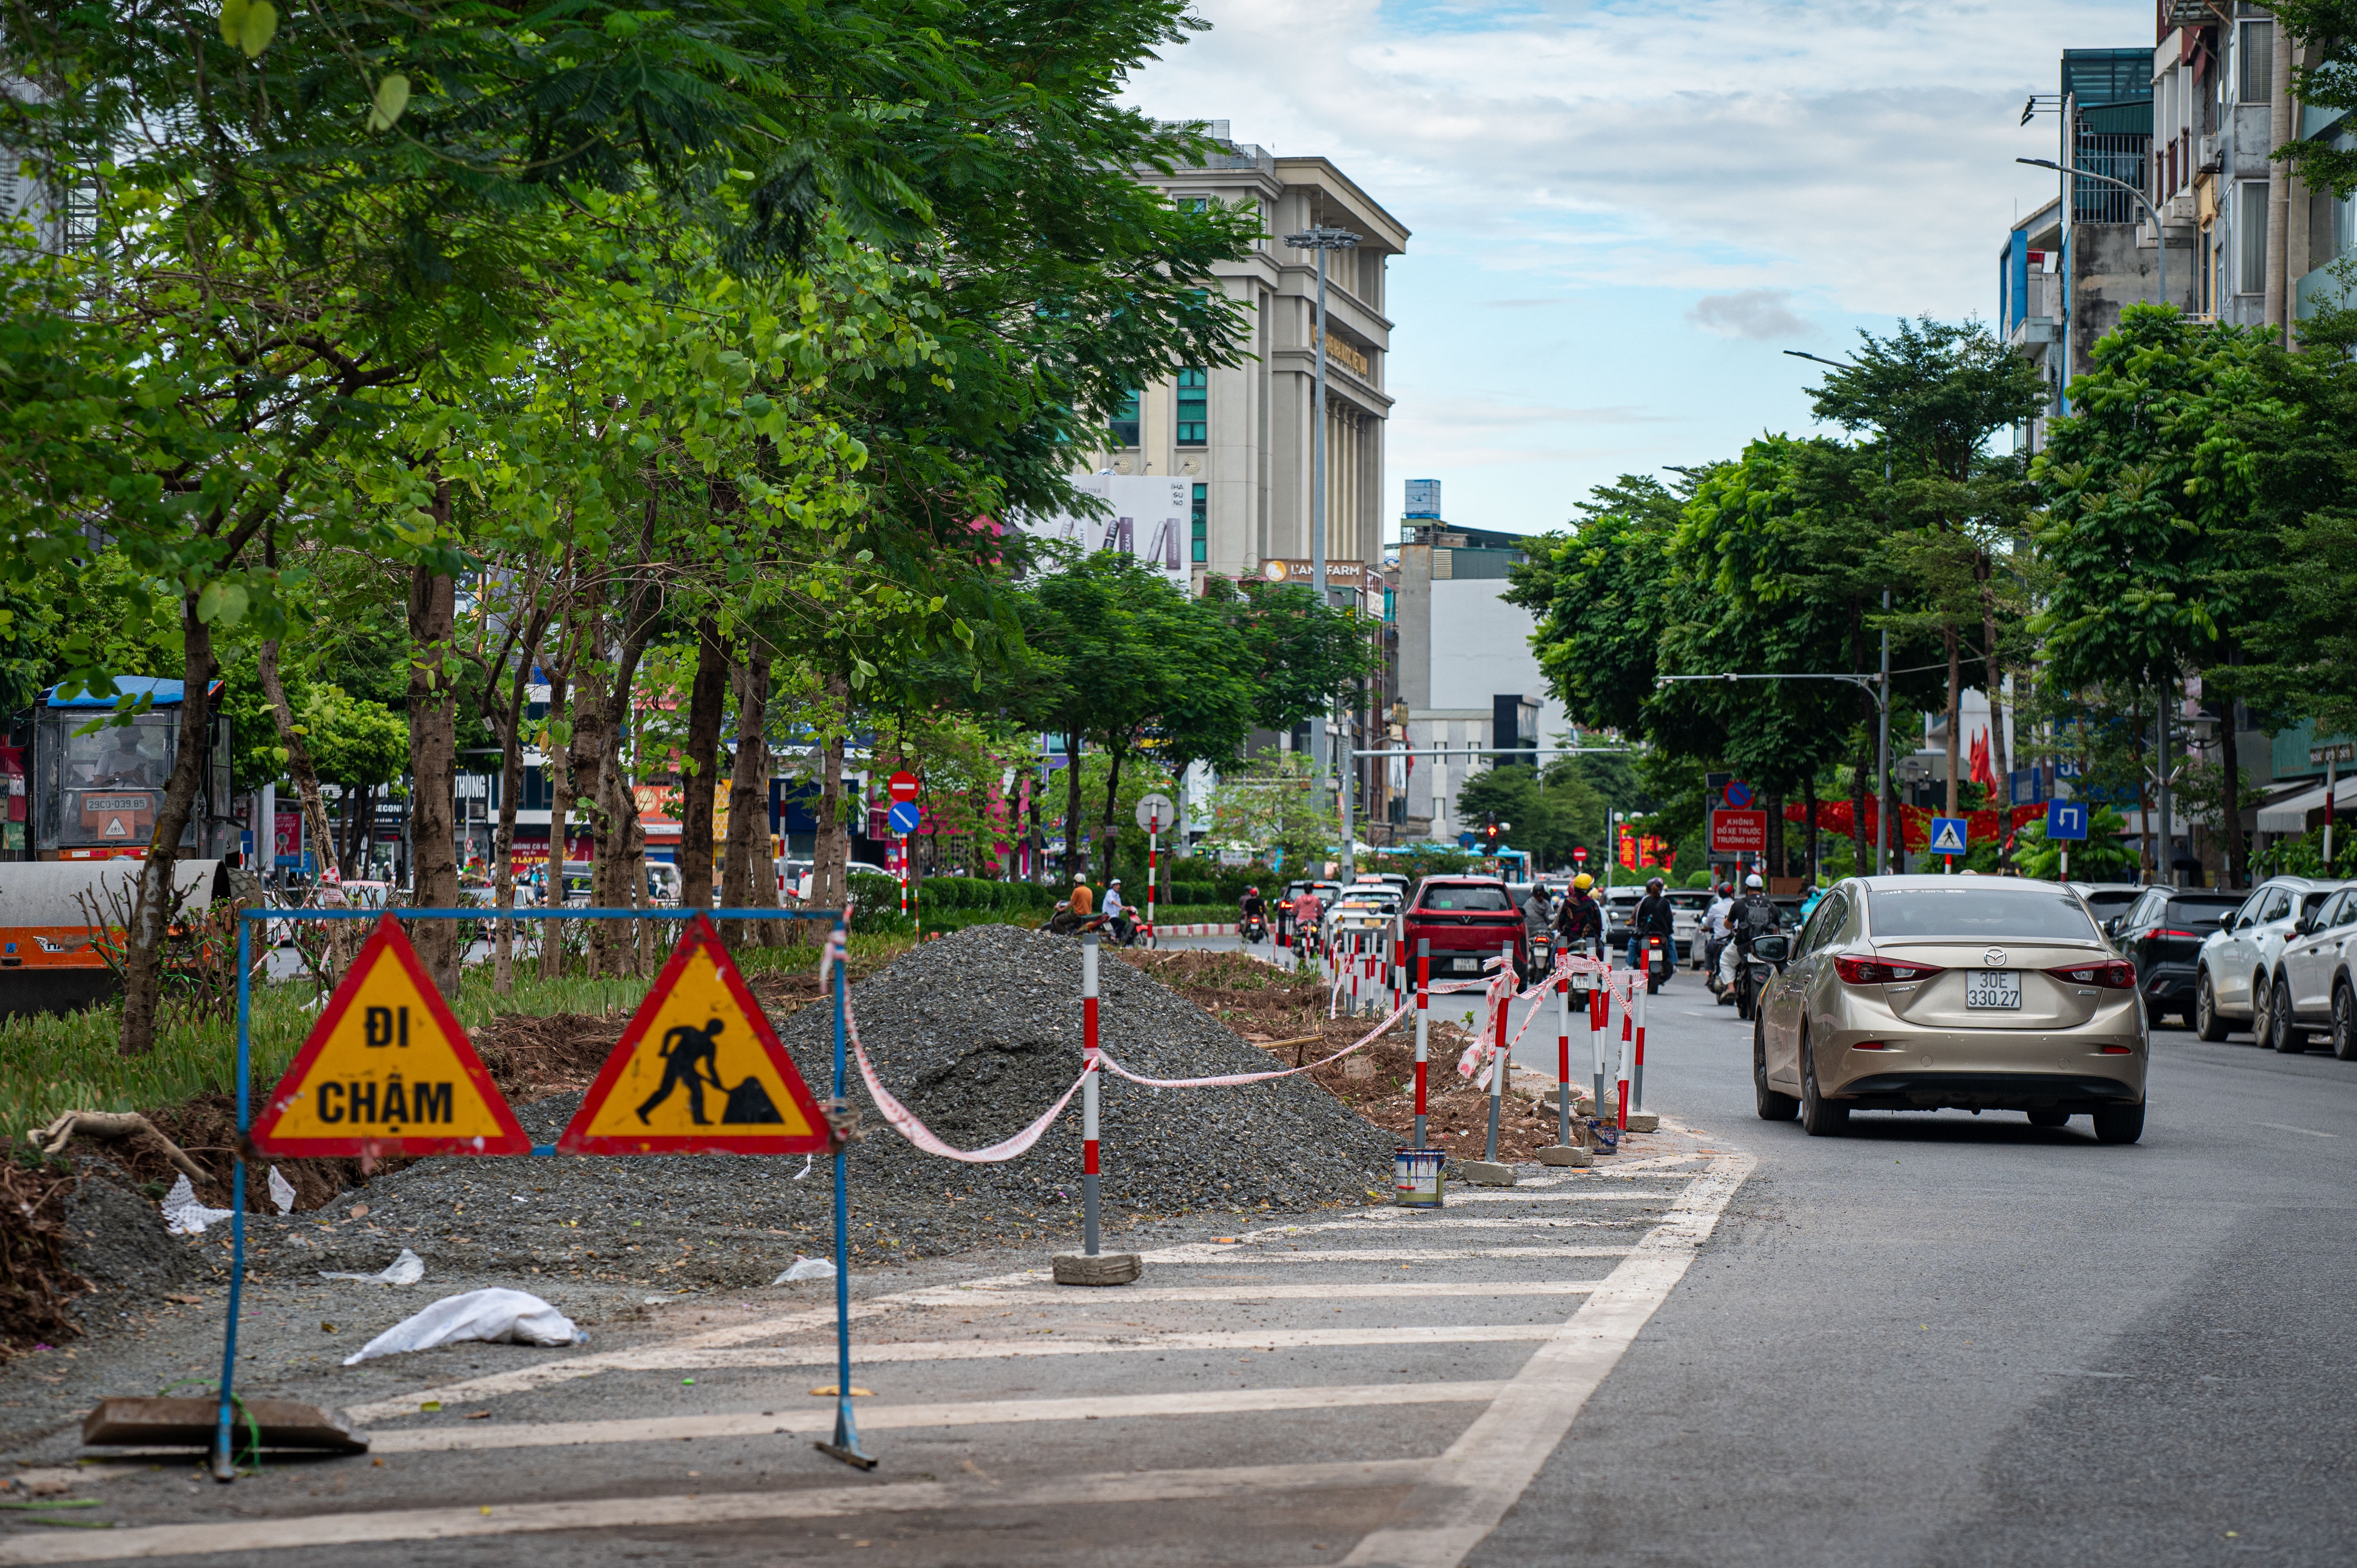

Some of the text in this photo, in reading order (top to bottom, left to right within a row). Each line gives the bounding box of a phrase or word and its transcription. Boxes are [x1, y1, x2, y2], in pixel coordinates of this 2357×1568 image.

[1291, 564, 1360, 576] L'ANFARM
[1727, 817, 1754, 826] KHÔNG
[1738, 826, 1761, 835] TRƯỚC
[532, 842, 541, 850] CÓ
[1717, 835, 1761, 845] TRƯỜNG HỌC
[1979, 972, 2008, 988] 30E
[1969, 990, 2019, 1006] 330.27
[364, 1006, 409, 1047] ĐI
[317, 1066, 453, 1133] CHẬM
